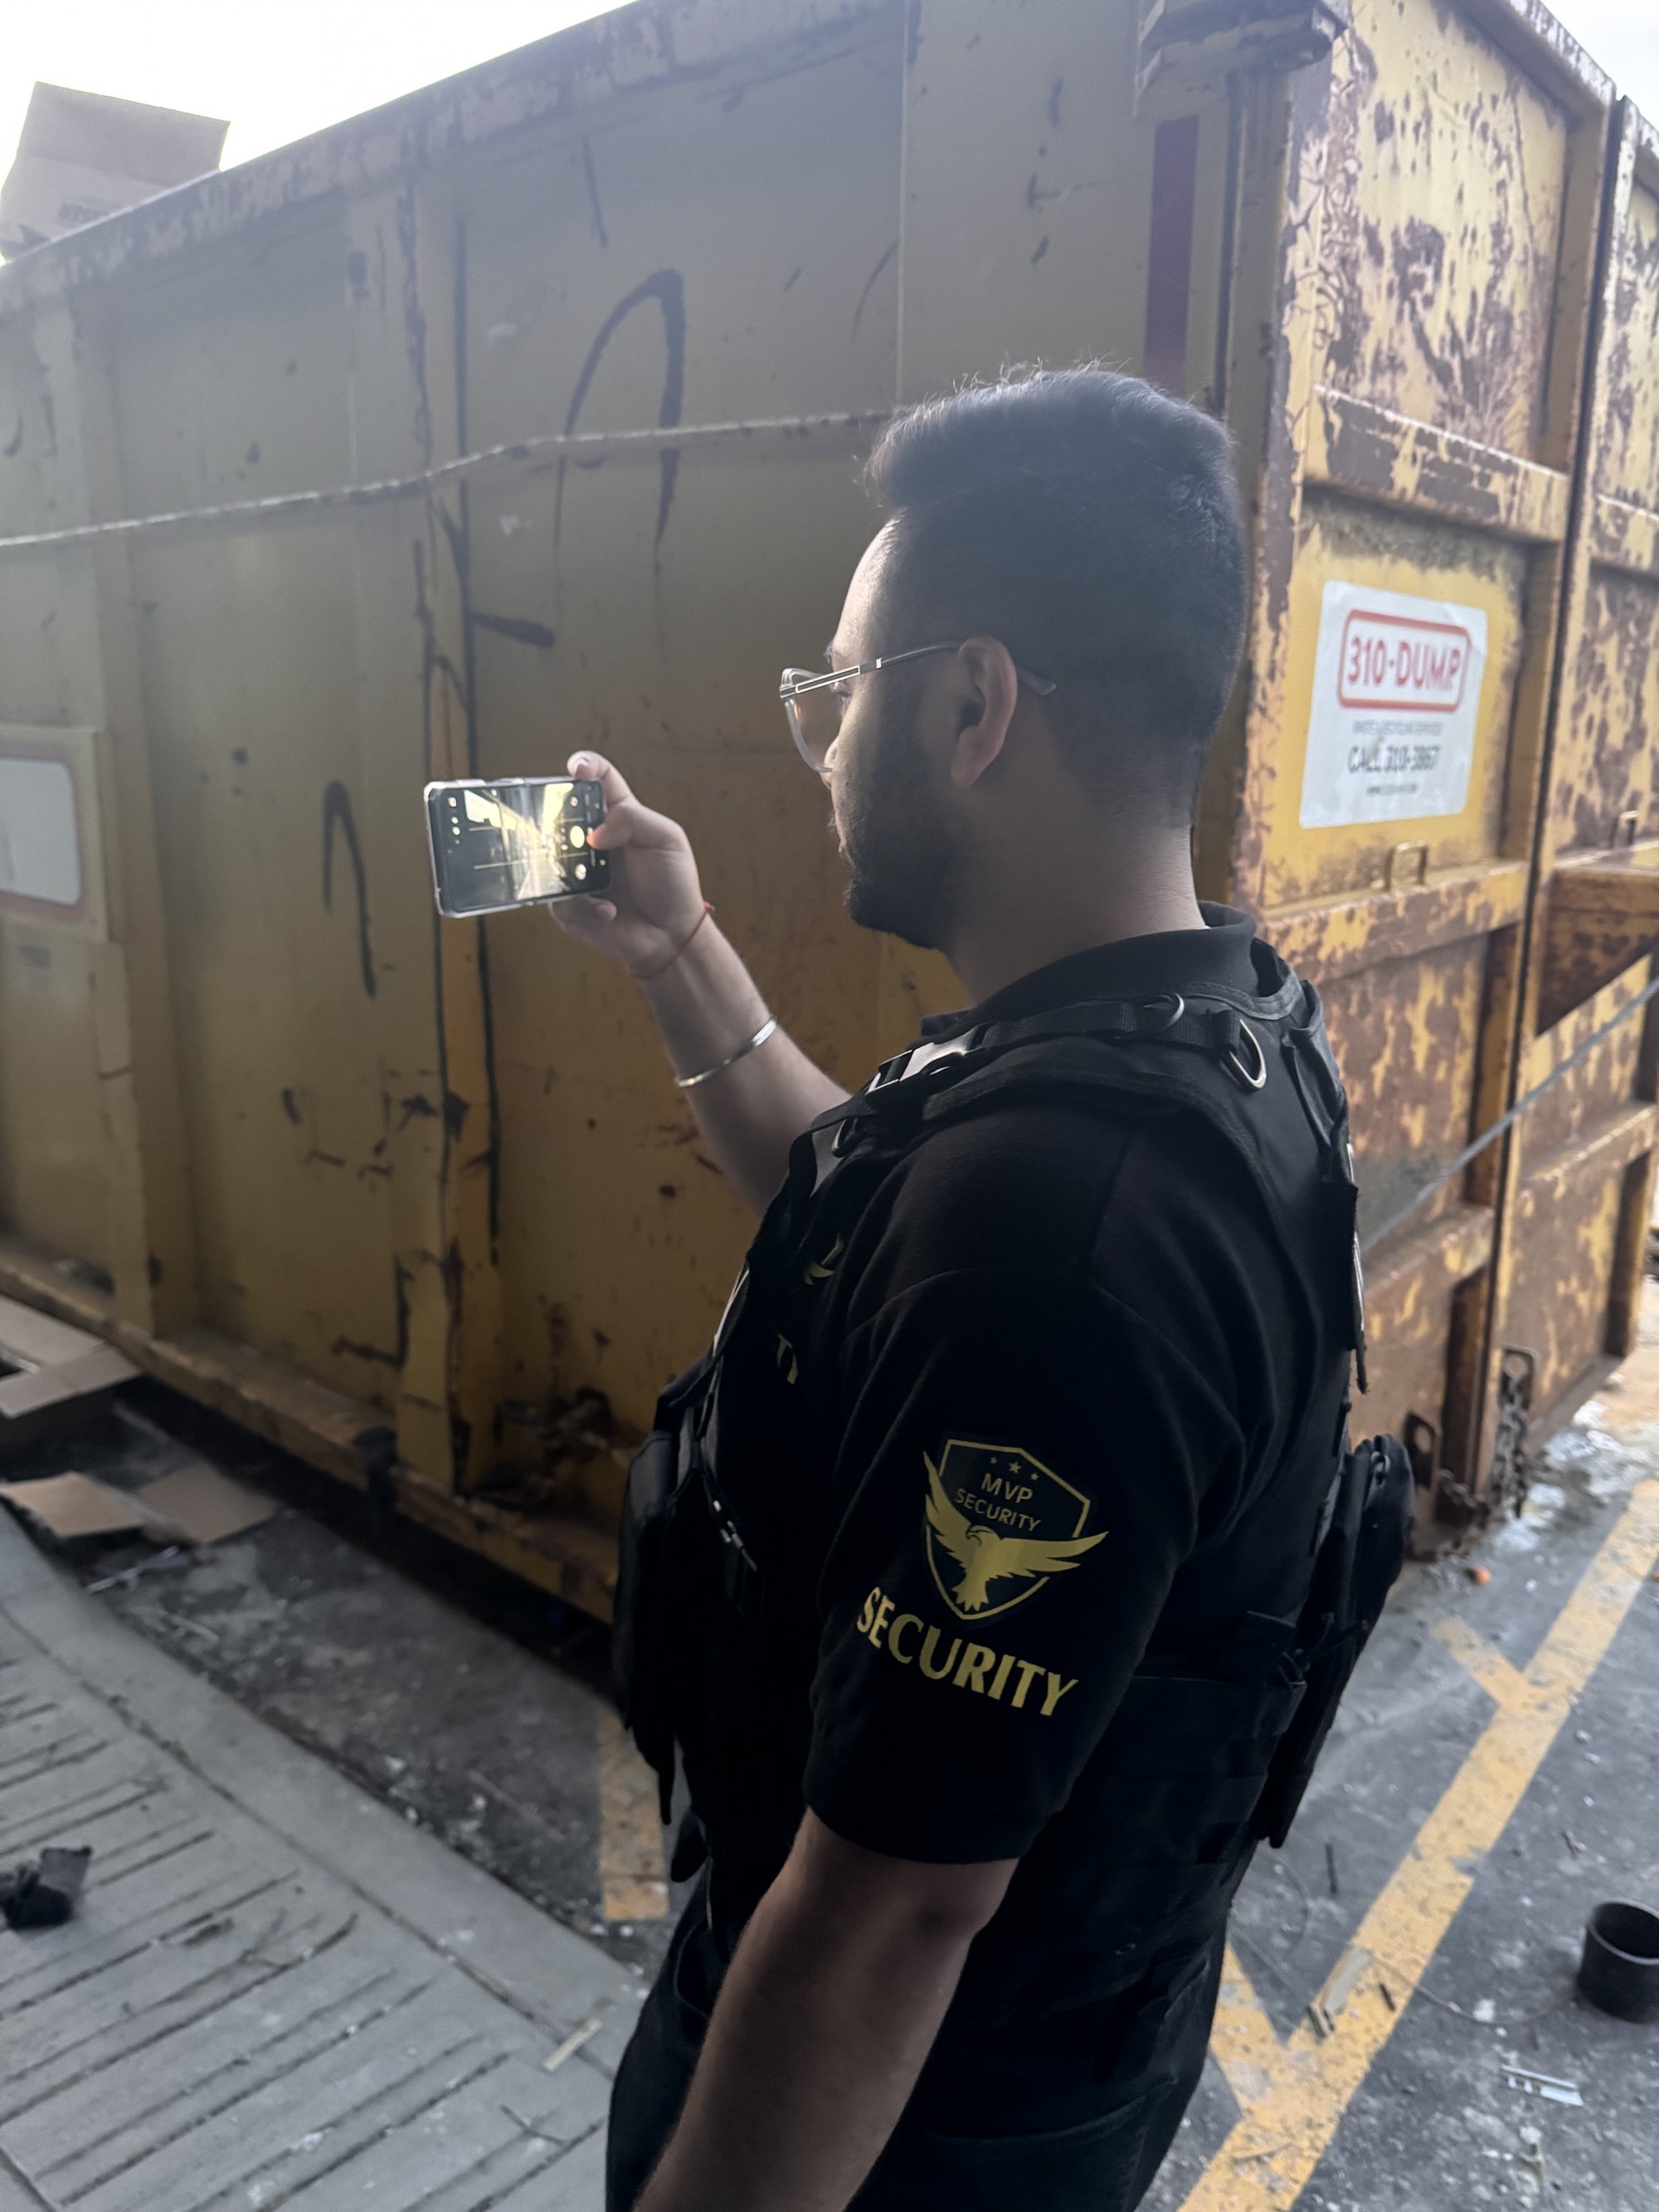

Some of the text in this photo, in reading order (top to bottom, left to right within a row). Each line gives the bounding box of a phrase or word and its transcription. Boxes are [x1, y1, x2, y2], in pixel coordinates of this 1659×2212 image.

[954, 1488, 1042, 1532] SECURITY
[980, 1472, 1034, 1504] MVP
[856, 1586, 1079, 1717] SECURITY
